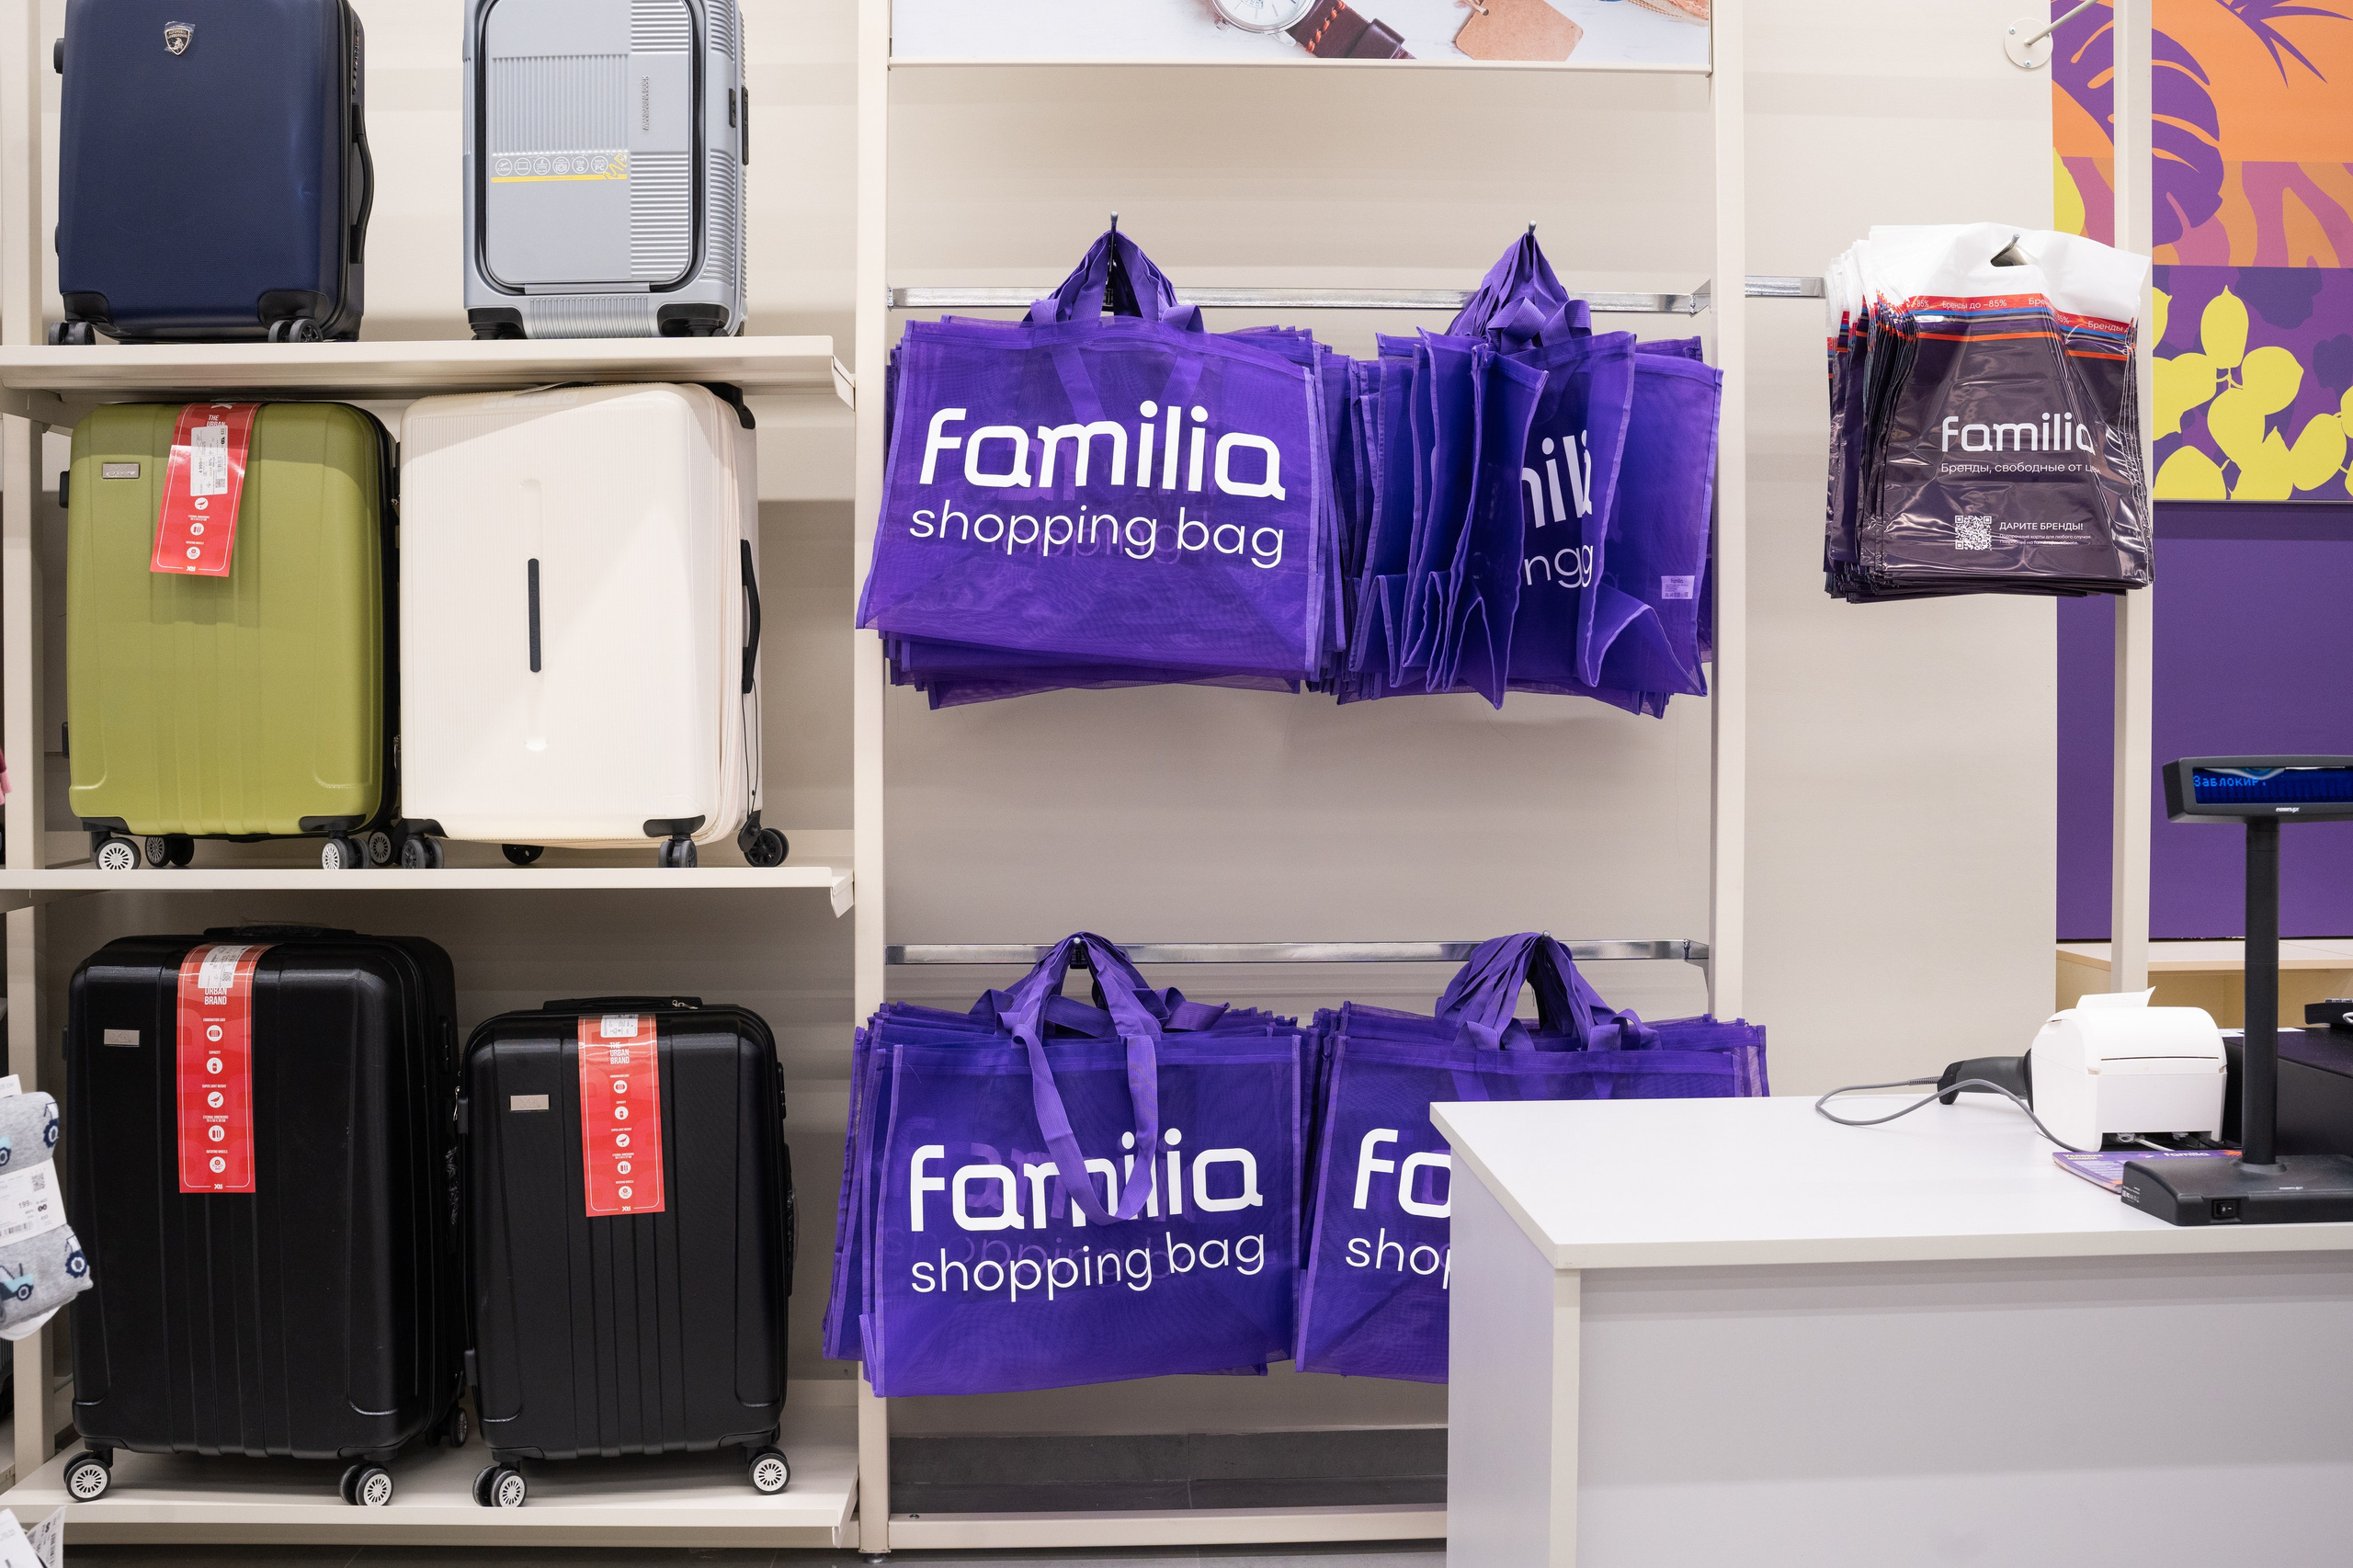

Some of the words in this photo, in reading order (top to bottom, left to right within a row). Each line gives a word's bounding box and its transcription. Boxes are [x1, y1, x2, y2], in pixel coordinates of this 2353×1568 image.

[1942, 301, 1968, 310] Бренды
[1969, 301, 1982, 310] до
[2087, 320, 2123, 332] Бренды
[1941, 412, 2097, 456] familia
[920, 400, 1286, 501] familia
[1941, 463, 1992, 475] Бренды,
[1995, 461, 2065, 474] свободные
[2068, 464, 2083, 472] от
[1999, 522, 2039, 531] ДАРИТЕ
[2040, 522, 2084, 531] БРЕНДЫ!
[910, 499, 1158, 560] shopping
[1176, 506, 1284, 569] bag
[204, 995, 227, 1006] BRAND
[609, 1049, 630, 1057] URBAN
[609, 1056, 630, 1064] BRAND
[912, 1245, 1153, 1302] shopping
[1165, 1232, 1265, 1276] bag
